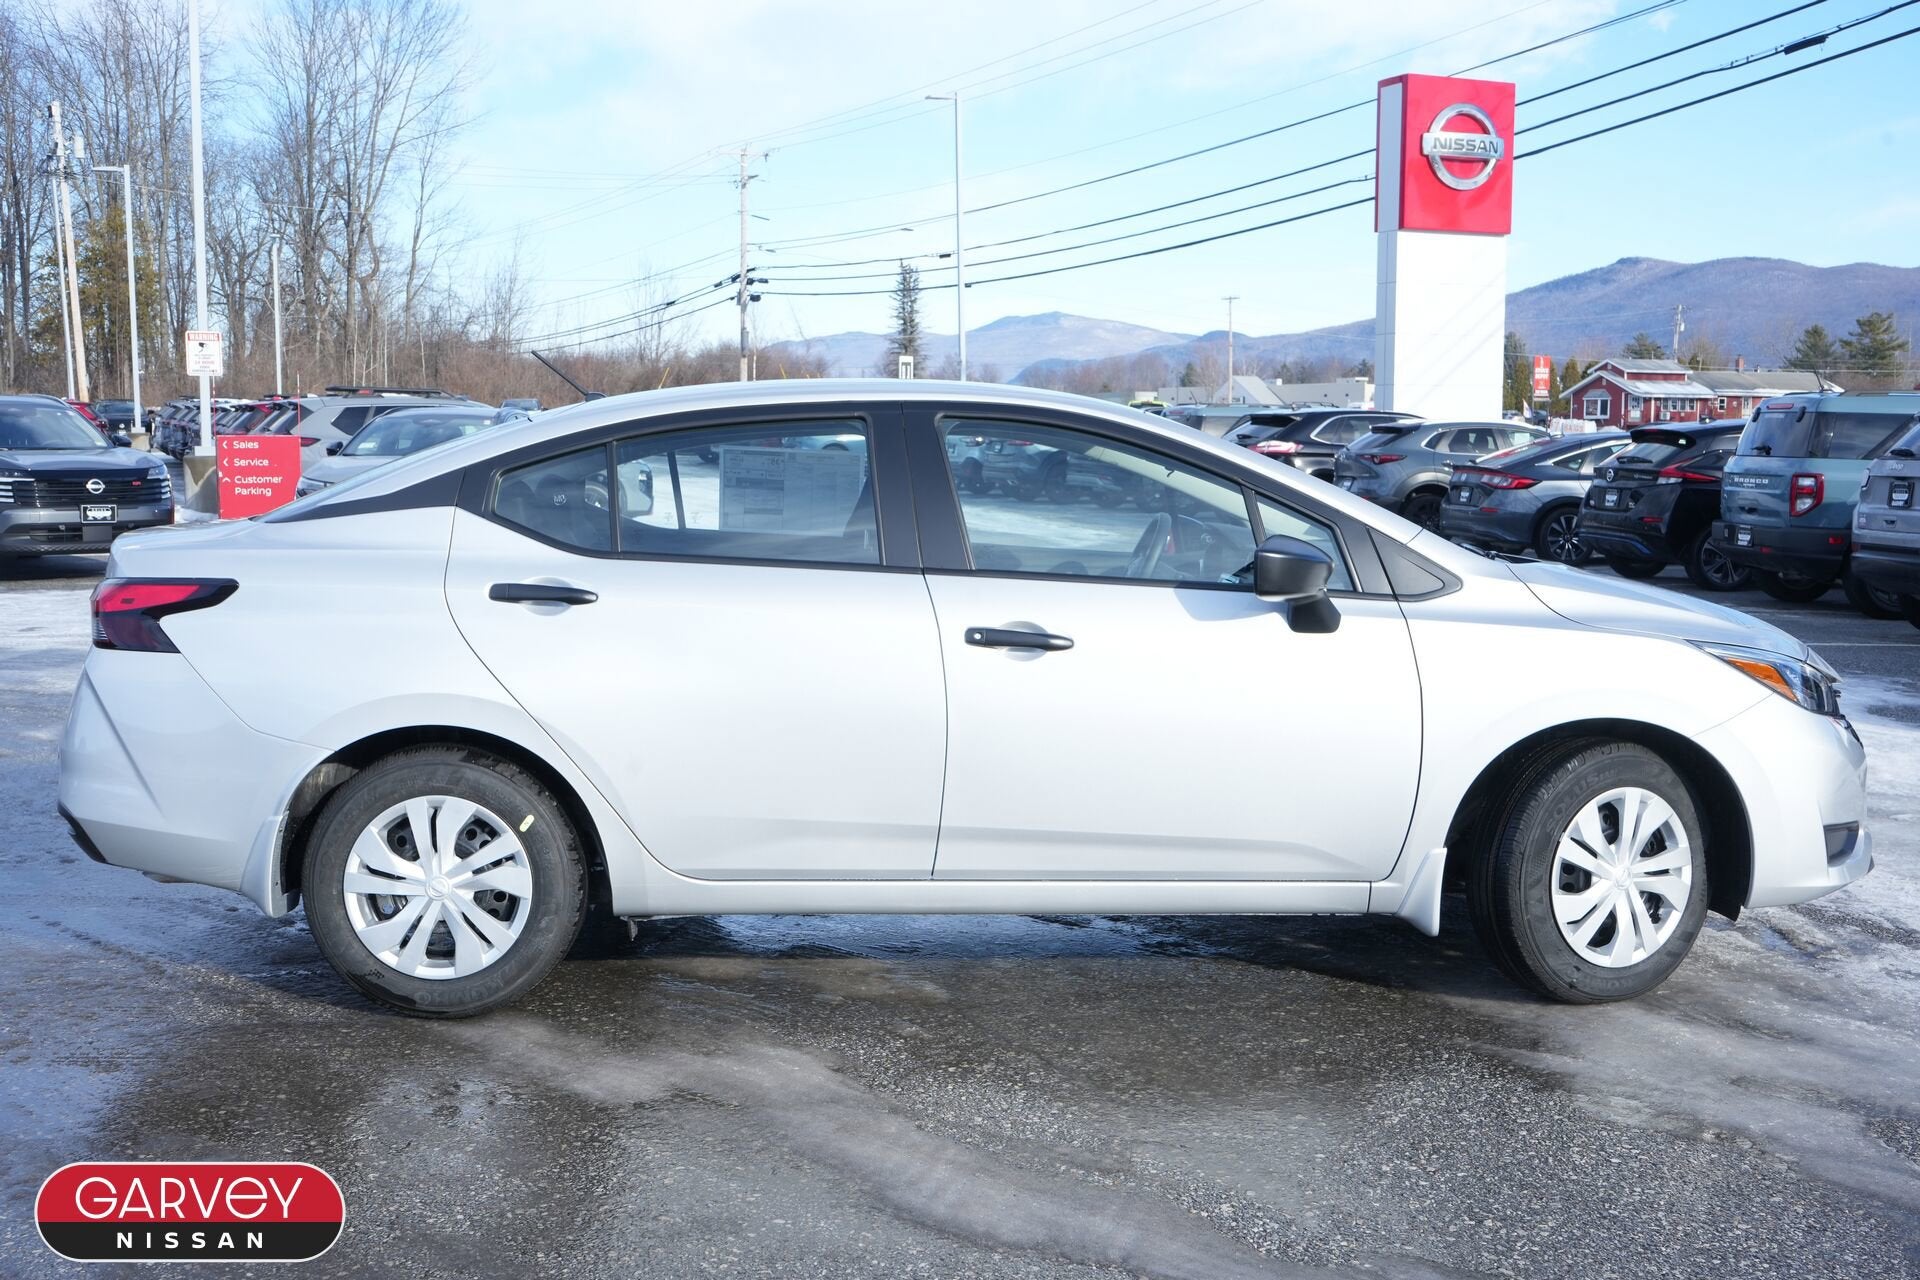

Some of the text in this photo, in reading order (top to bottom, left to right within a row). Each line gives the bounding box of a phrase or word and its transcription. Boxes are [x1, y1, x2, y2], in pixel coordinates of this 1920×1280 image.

[1433, 137, 1499, 154] NISSAN
[189, 333, 219, 341] WARNING
[233, 440, 259, 449] Sales
[234, 458, 269, 466] Service
[234, 475, 283, 484] Customer
[235, 487, 272, 496] Parking
